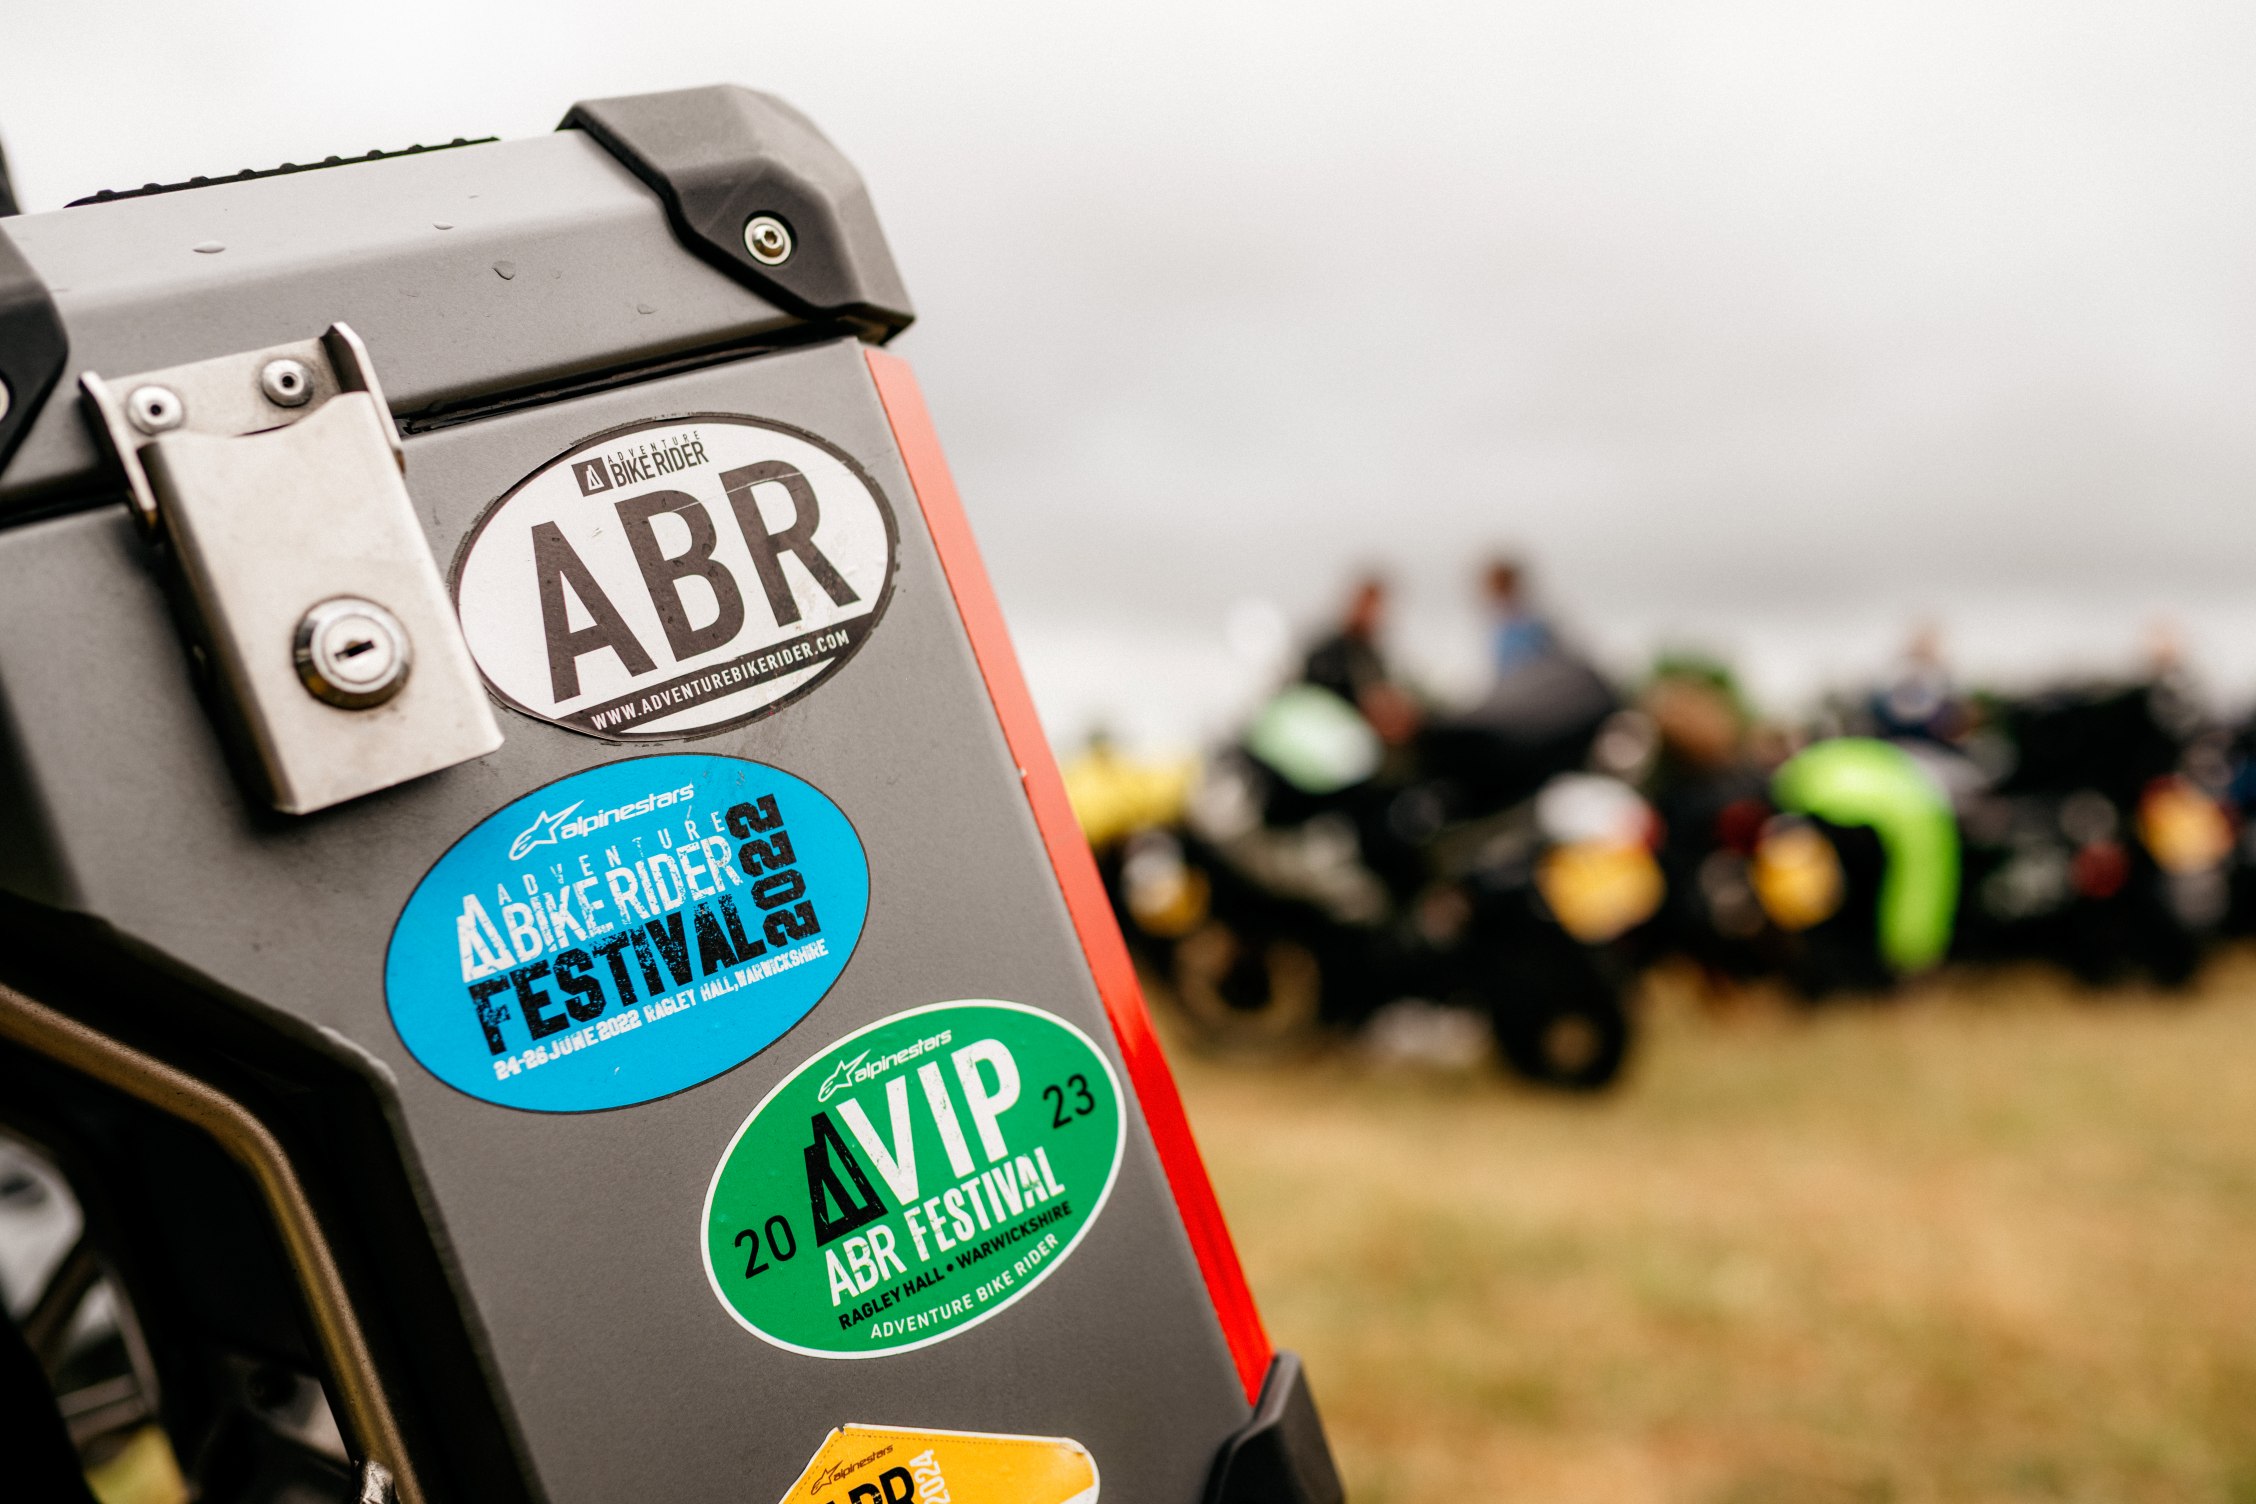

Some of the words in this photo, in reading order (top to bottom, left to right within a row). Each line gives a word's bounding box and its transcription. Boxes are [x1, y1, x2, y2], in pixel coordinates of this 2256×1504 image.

[607, 430, 701, 464] ADVENTURE
[611, 454, 656, 488] BIKE
[652, 441, 710, 477] RIDER
[530, 459, 861, 704] ABR
[590, 629, 850, 731] WWW.ADVENTUREBIKERIDER.COM
[496, 810, 727, 906] ADVENTURE
[560, 784, 695, 839] alpinestars
[502, 875, 614, 964] BIKE
[606, 835, 744, 925] RIDER
[724, 793, 821, 948] 2022
[467, 893, 767, 1057] FESTIVAL
[492, 1045, 549, 1081] 24-26
[547, 1025, 599, 1061] JUNE
[594, 1010, 643, 1041] 2022
[645, 989, 699, 1024] RAGLEY
[854, 1028, 954, 1084] alpinestars
[835, 1038, 1022, 1208] VIP
[1041, 1072, 1097, 1130] 23
[733, 1214, 797, 1280] 20
[824, 1223, 908, 1307] ABR
[903, 1146, 1066, 1263] FESTIVAL
[838, 1286, 904, 1331] RAGLEY
[903, 1267, 946, 1298] HALL
[955, 1200, 1073, 1270] WARWICKSHIRE
[869, 1293, 975, 1340] ADVENTURE
[976, 1269, 1015, 1303] BIKE
[1013, 1232, 1060, 1277] RIDER
[833, 1444, 894, 1482] alpinestars
